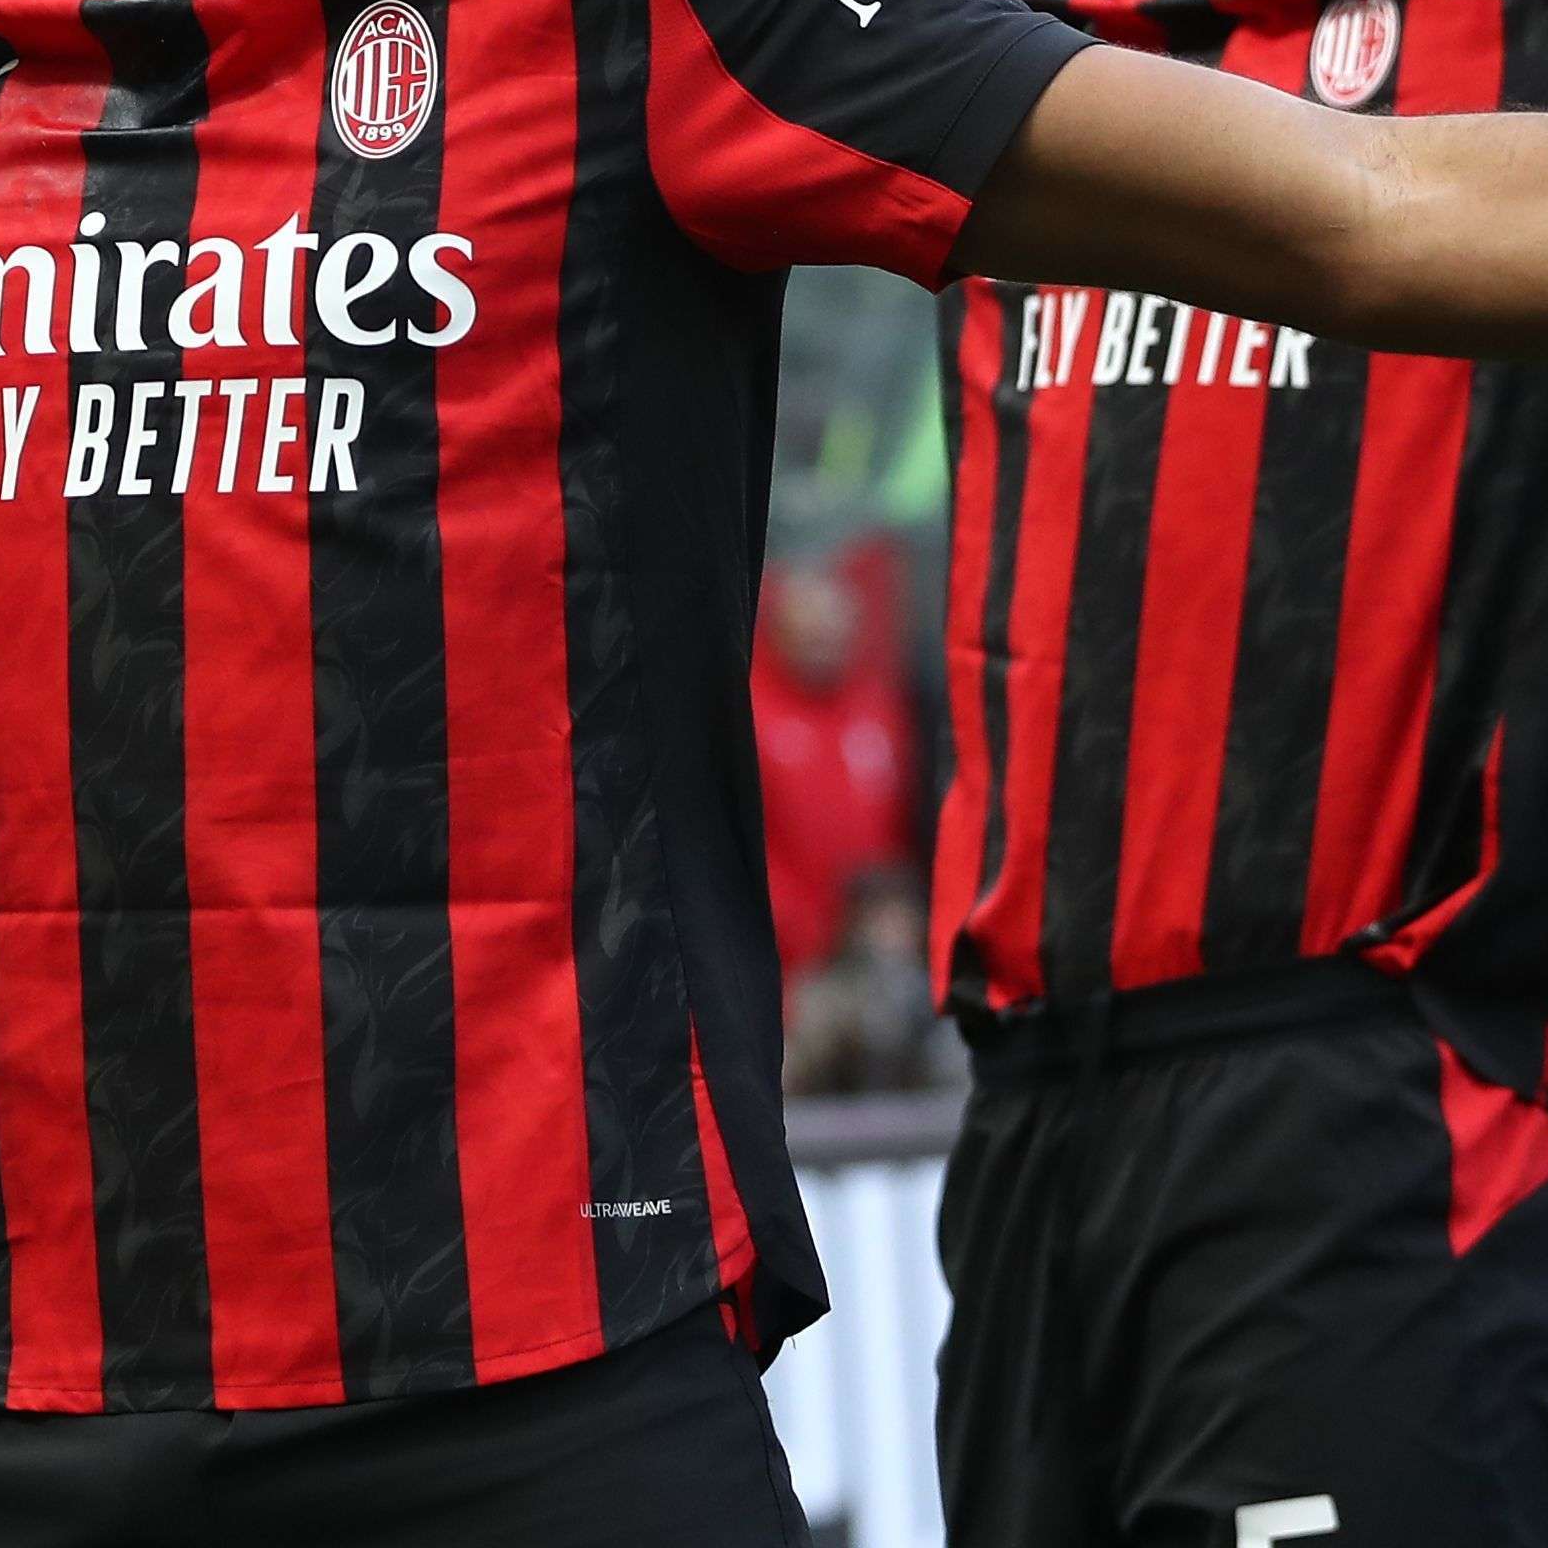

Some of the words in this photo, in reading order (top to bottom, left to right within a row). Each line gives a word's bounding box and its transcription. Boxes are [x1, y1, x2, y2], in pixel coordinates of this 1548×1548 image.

[358, 13, 416, 47] ACM
[357, 122, 407, 142] 1899
[1016, 290, 1092, 393] FLY
[62, 377, 366, 499] BETTER
[579, 1198, 672, 1219] ULTRAWEAVE
